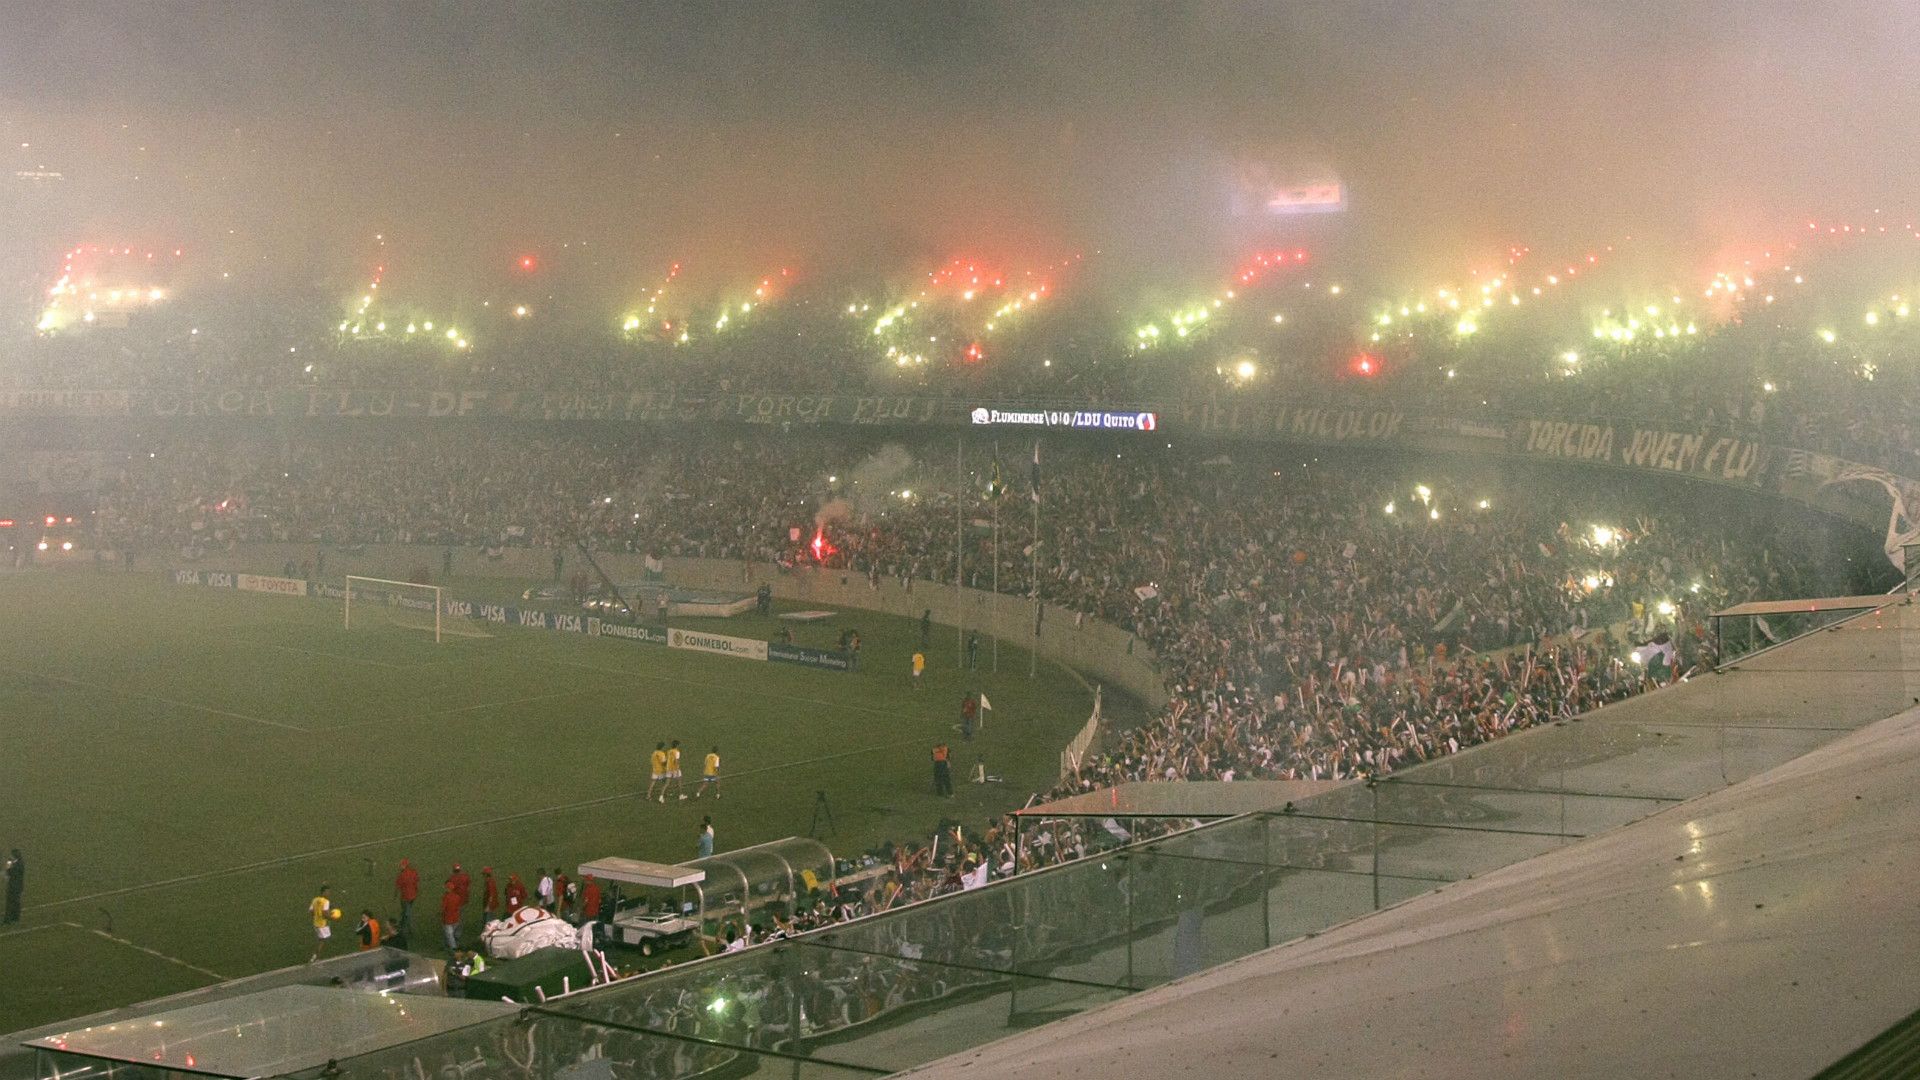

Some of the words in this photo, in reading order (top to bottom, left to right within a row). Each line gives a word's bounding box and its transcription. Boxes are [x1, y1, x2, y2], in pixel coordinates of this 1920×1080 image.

[1077, 412, 1101, 427] LDU
[1526, 420, 1614, 462] TORCIDA
[1622, 430, 1704, 472] JOVEM
[1703, 437, 1759, 479] FLU
[175, 570, 200, 585] VISA
[206, 572, 232, 588] VISA
[260, 578, 299, 594] TOYOTA
[446, 600, 473, 616] VISA
[480, 603, 506, 624] VISA
[518, 609, 546, 629] VISA
[554, 614, 583, 633] VISA
